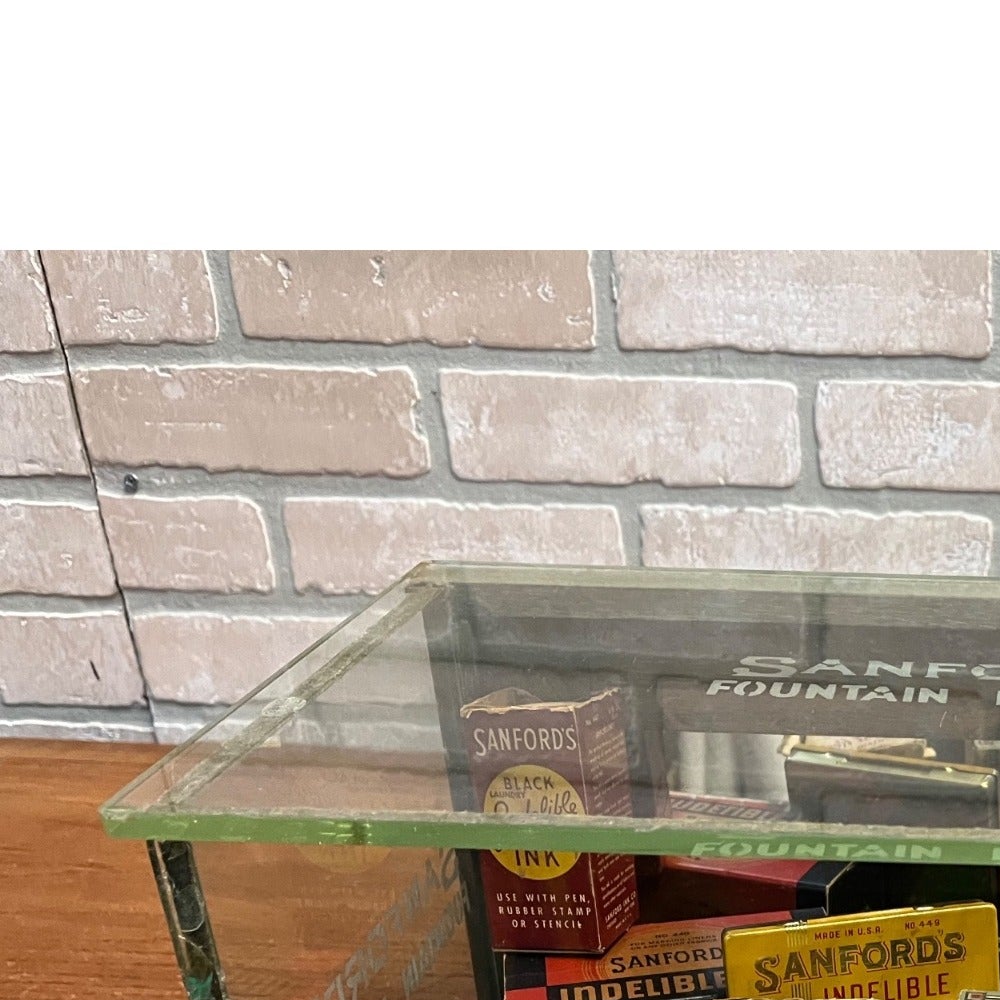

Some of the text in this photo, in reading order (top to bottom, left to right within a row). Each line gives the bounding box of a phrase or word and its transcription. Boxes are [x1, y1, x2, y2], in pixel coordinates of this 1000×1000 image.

[706, 679, 949, 704] FOUNTAIN
[474, 725, 577, 757] SANFORD'S
[503, 776, 555, 791] BLACK
[515, 849, 560, 868] INK
[690, 841, 943, 861] FOUNTAIN
[496, 893, 591, 904] USE WITH PEN,
[498, 906, 592, 917] RUBBER STAMP
[512, 919, 582, 929] OR STENCIL
[814, 926, 884, 941] MADE IN U.S.A.
[754, 929, 967, 997] SANFORD'S
[823, 973, 951, 1000] INDELIBLE
